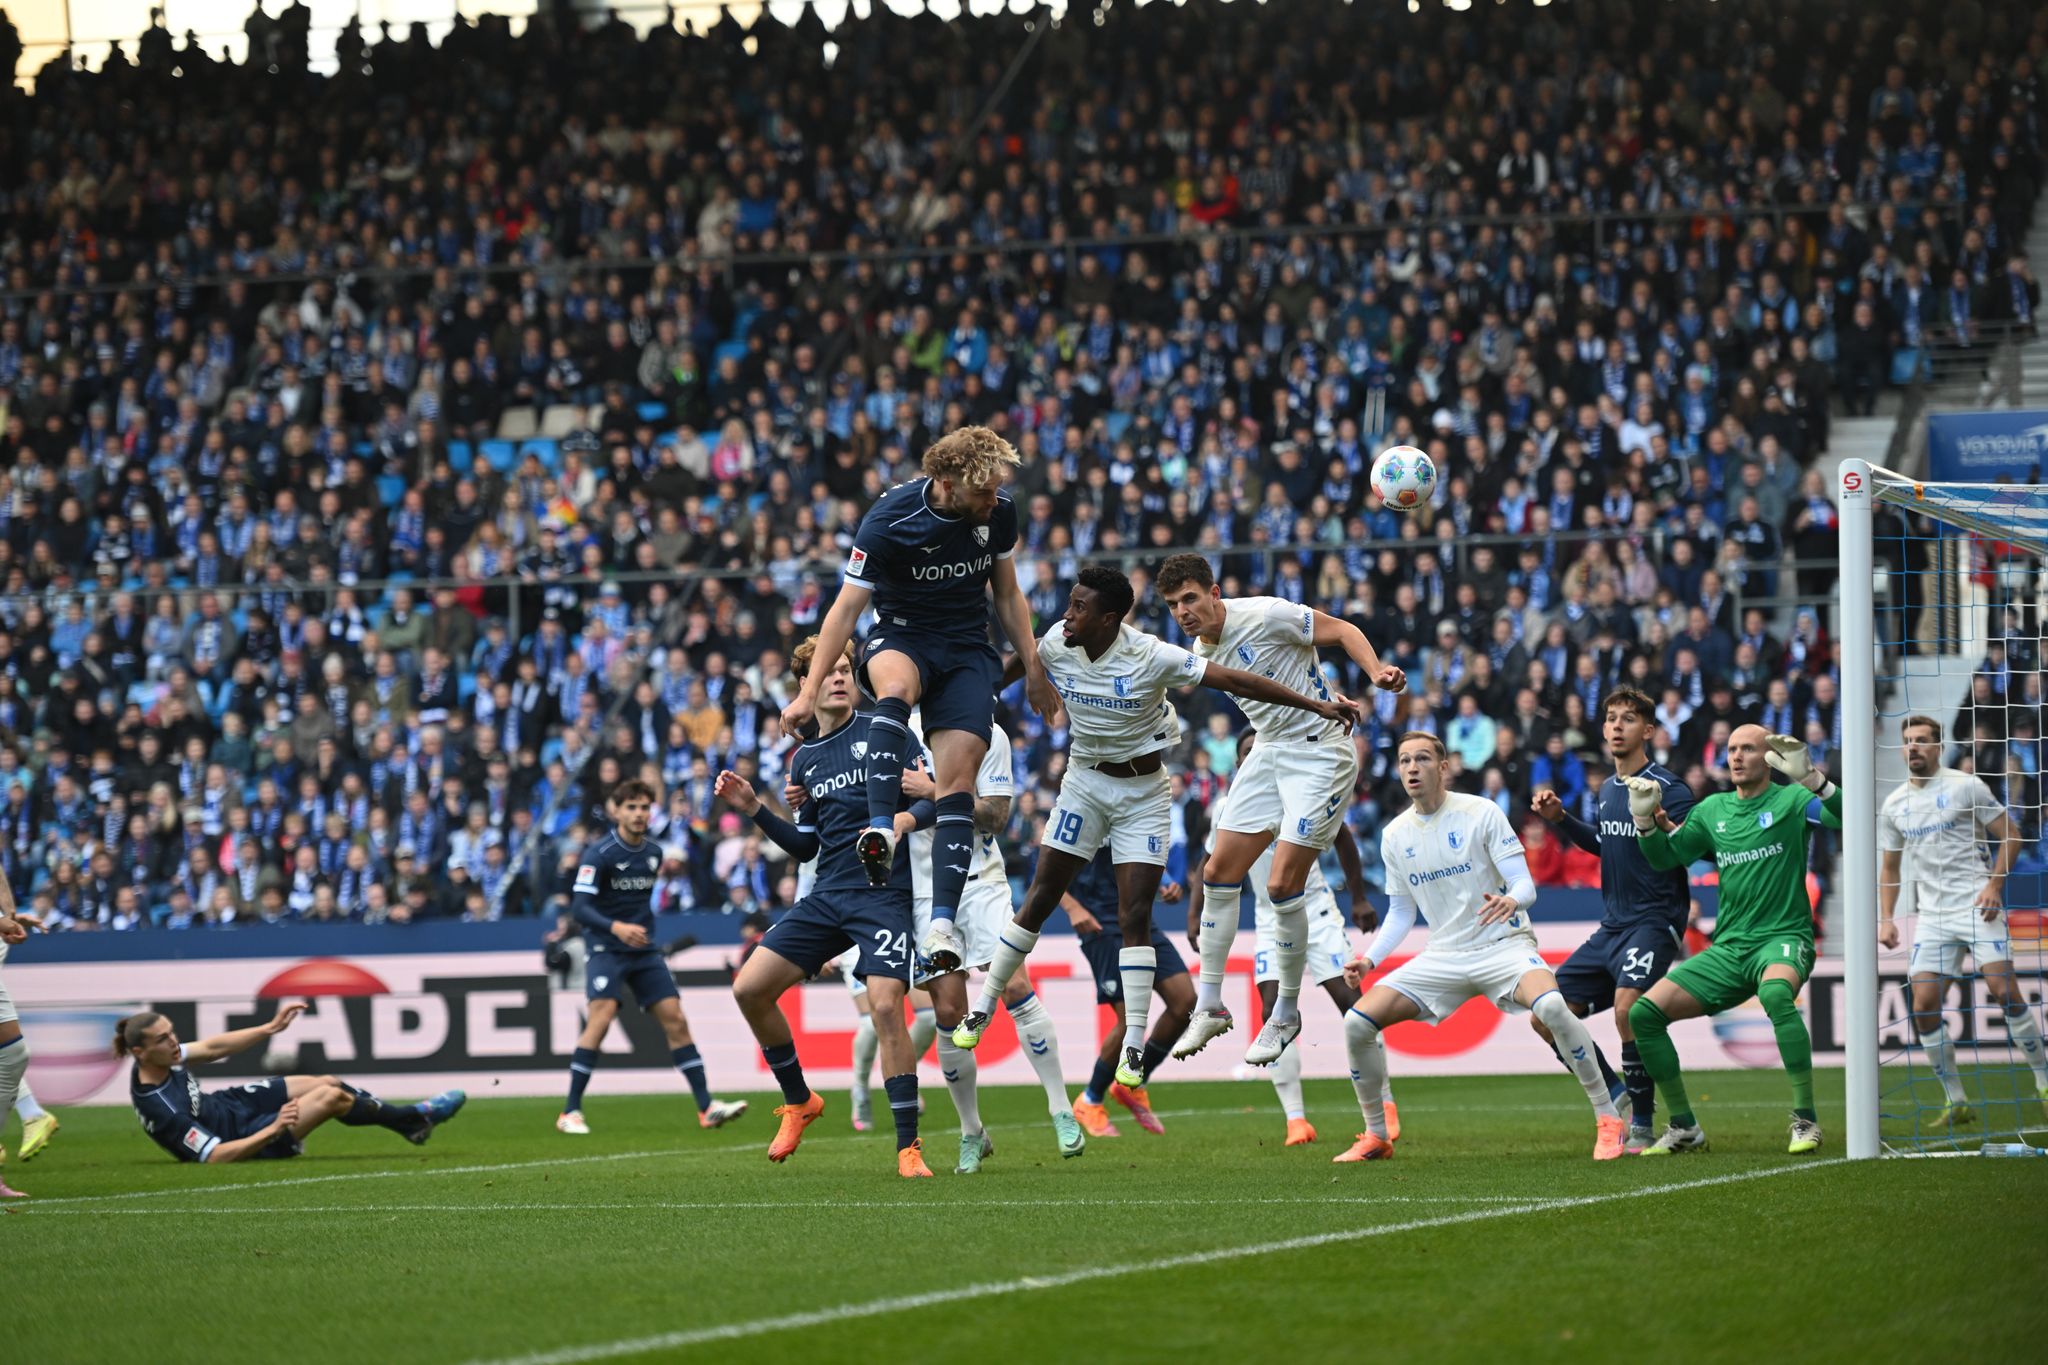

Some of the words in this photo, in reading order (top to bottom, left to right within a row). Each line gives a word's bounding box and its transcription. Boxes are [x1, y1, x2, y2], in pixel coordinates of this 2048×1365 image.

[1302, 612, 1312, 635] SWM
[1071, 690, 1141, 709] Humanas
[1053, 808, 1084, 845] 19
[1724, 841, 1783, 867] Humanas
[1419, 861, 1472, 884] Humanas
[874, 929, 907, 959] 24
[1780, 943, 1790, 957] 1
[1622, 947, 1655, 975] 34
